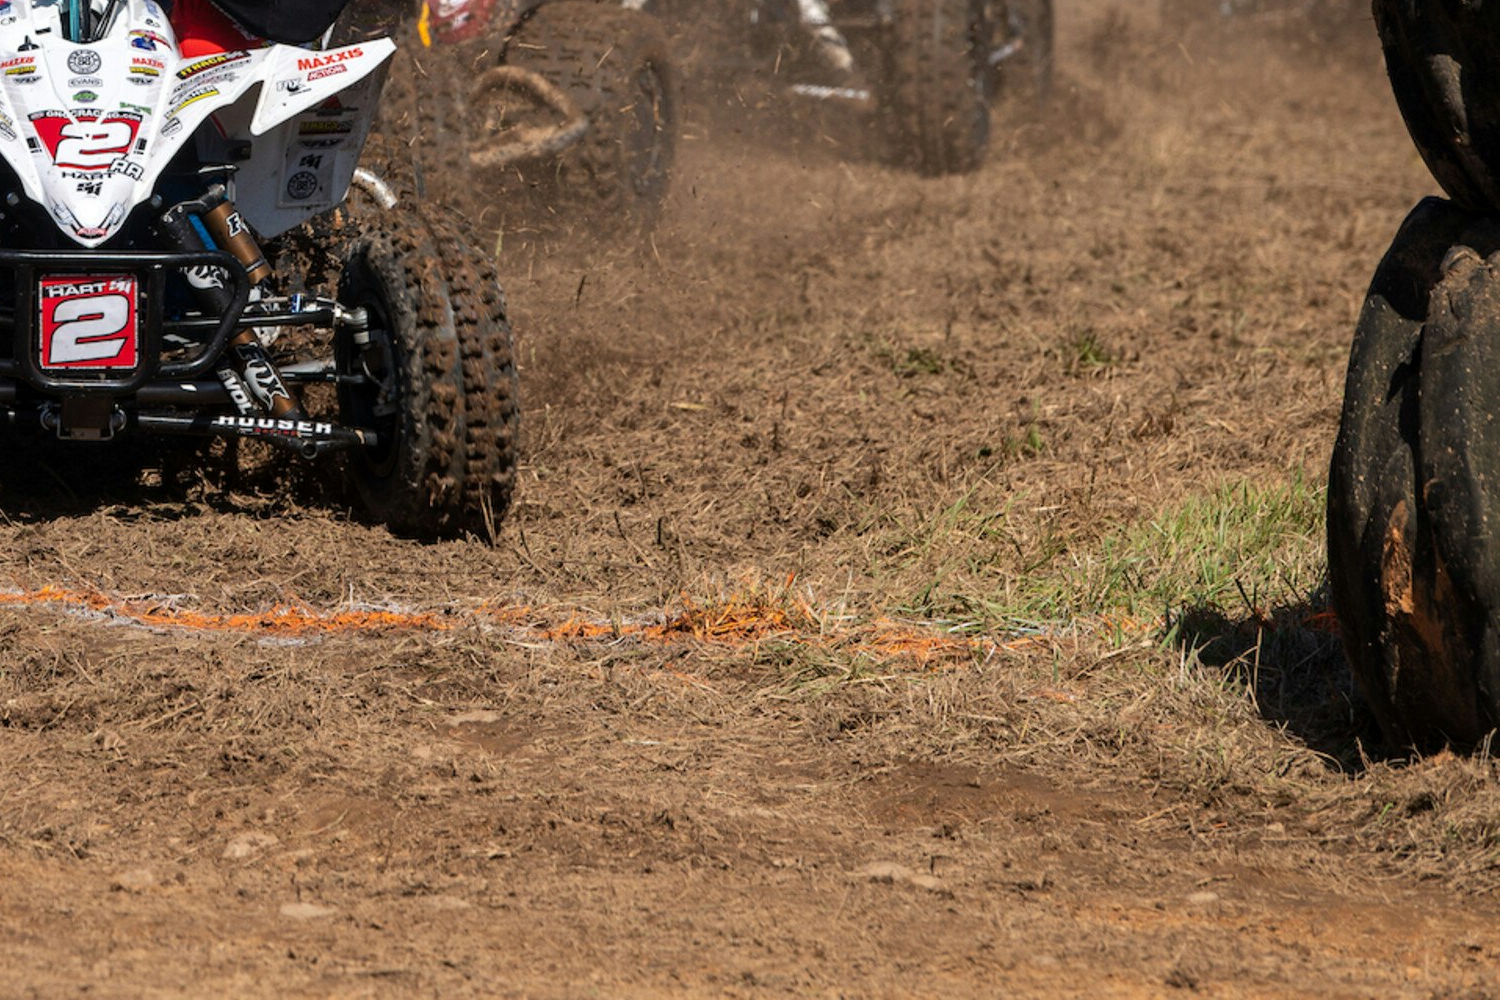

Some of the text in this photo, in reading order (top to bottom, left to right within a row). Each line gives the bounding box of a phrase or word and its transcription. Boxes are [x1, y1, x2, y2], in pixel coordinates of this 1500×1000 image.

[297, 47, 364, 71] MAXXIS
[54, 120, 133, 166] 2
[62, 170, 116, 181] HART
[49, 282, 106, 298] HART
[50, 294, 130, 364] 2
[218, 415, 332, 433] HOUSER
